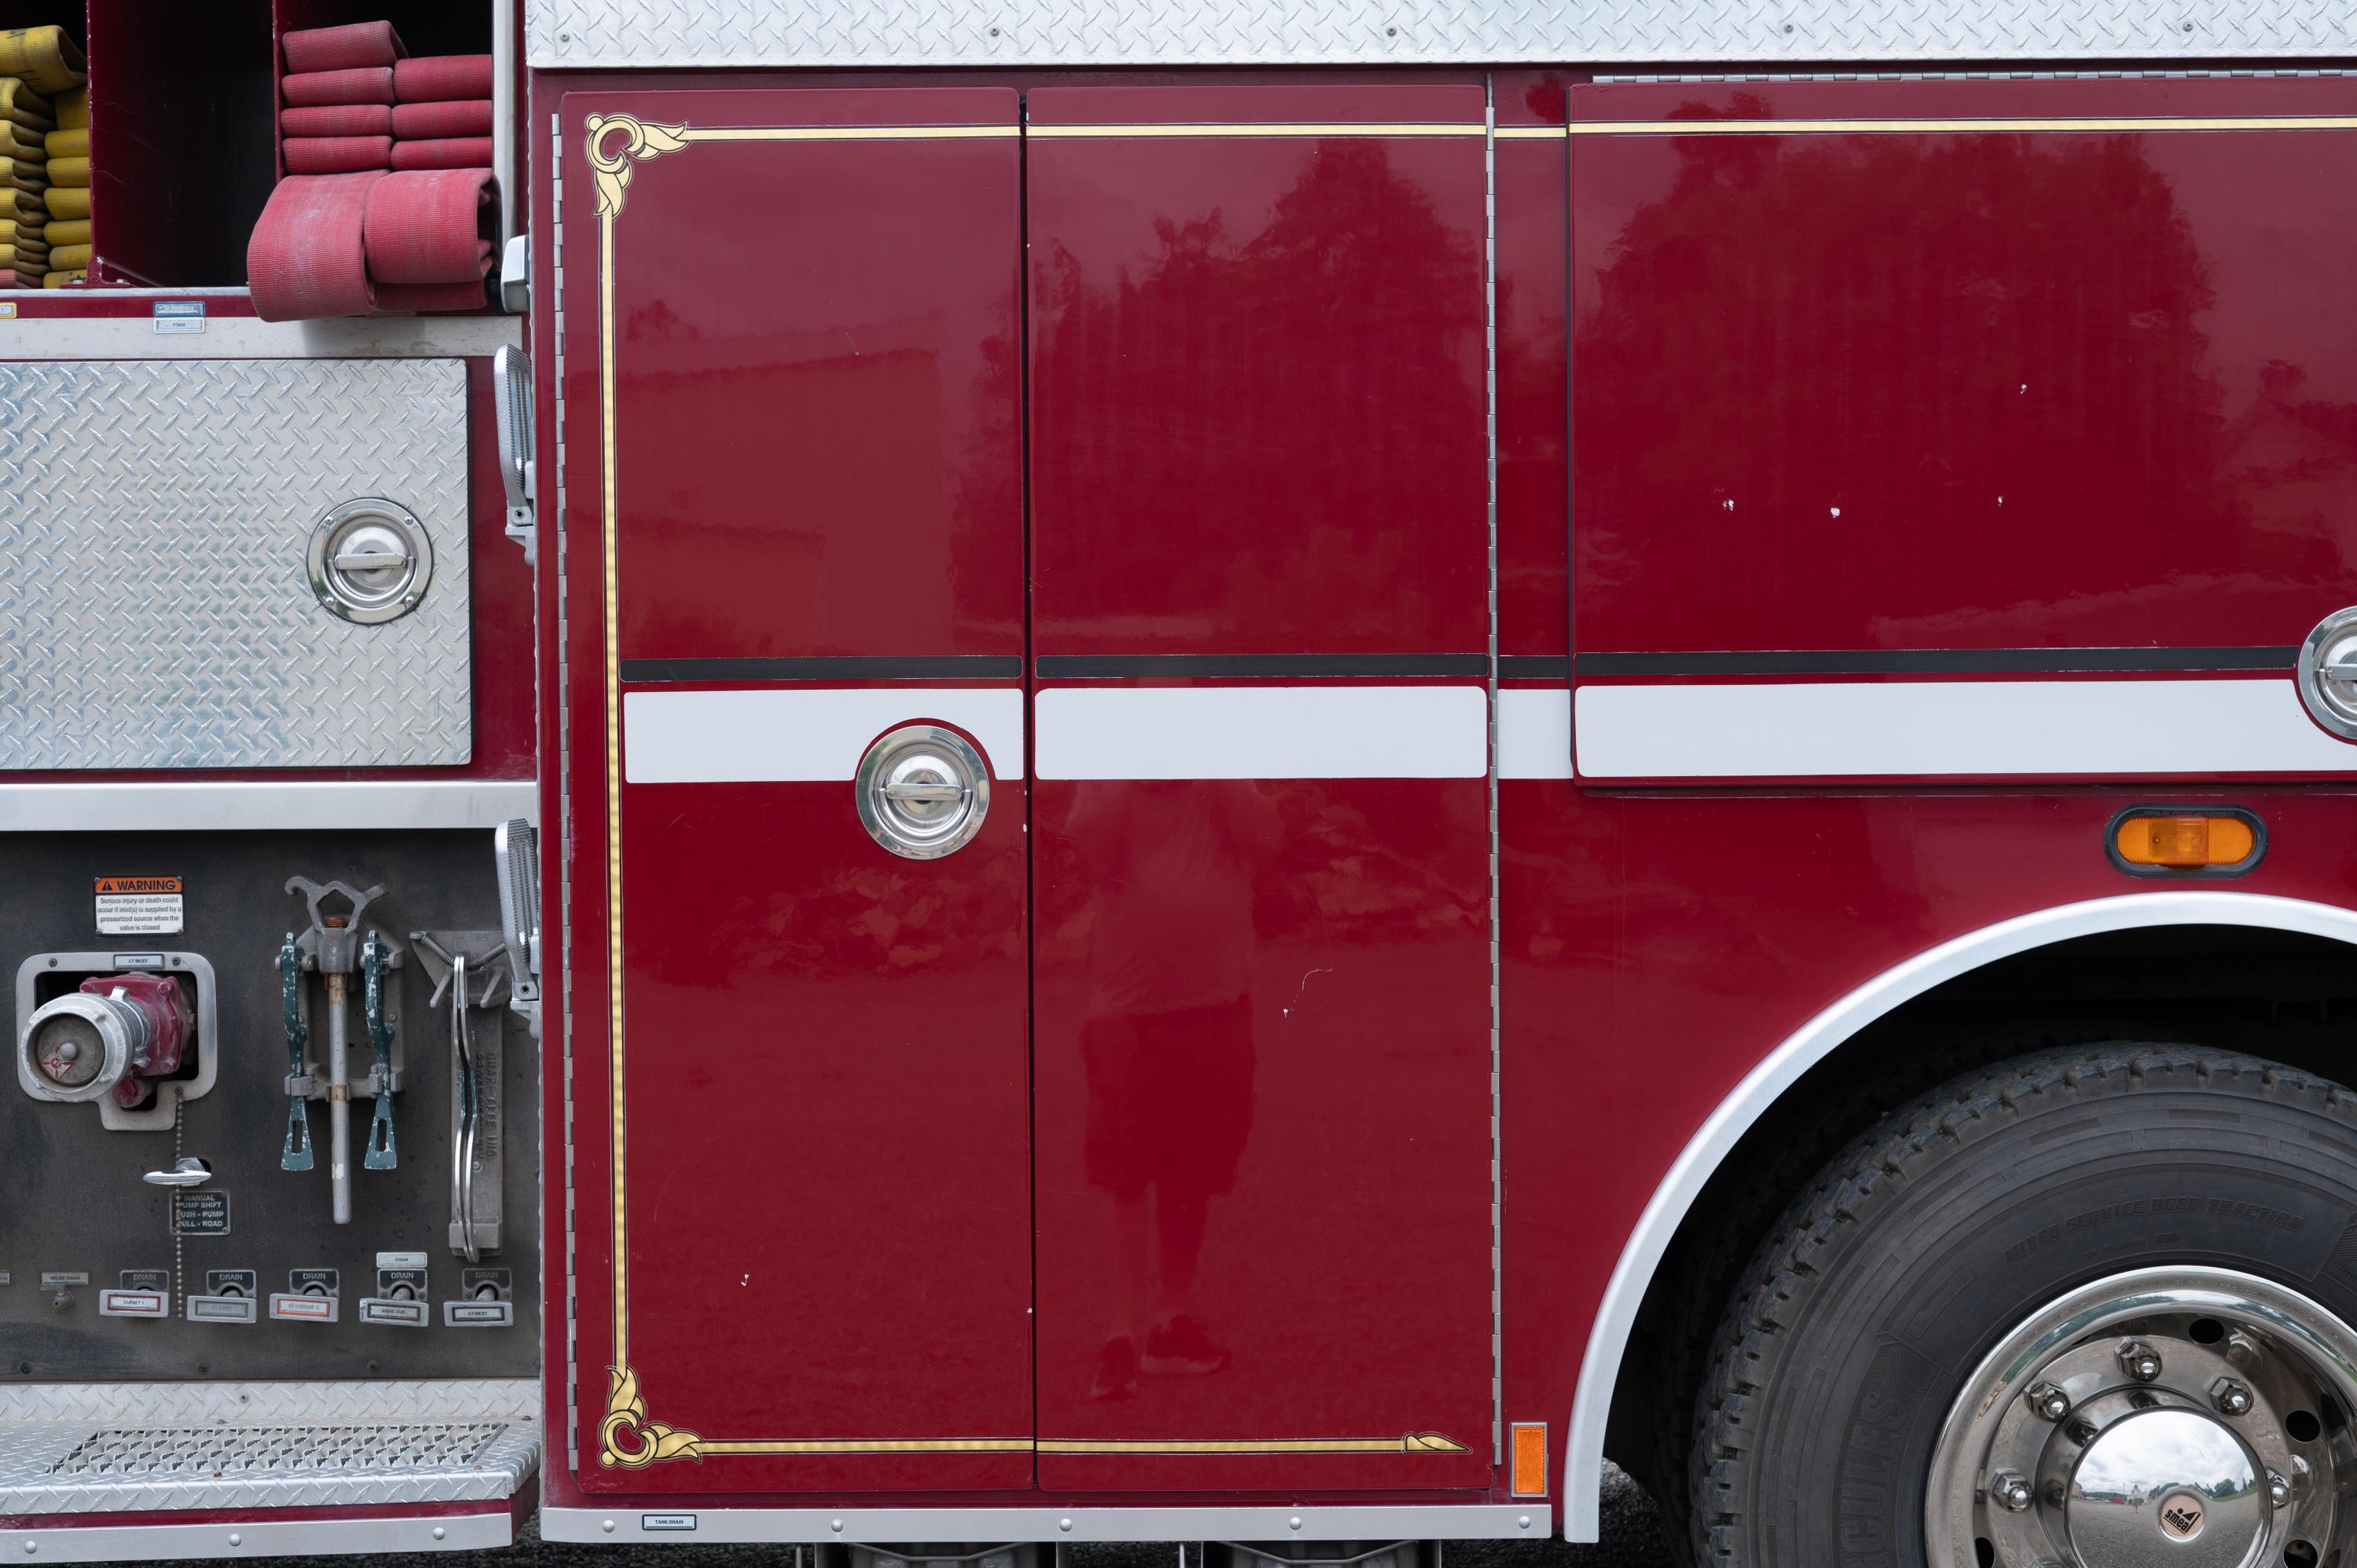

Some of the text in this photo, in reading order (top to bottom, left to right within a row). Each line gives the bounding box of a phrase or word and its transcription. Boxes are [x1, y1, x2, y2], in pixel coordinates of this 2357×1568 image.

[116, 880, 176, 891] WARNING
[2003, 1223, 2062, 1267] MIXED
[2066, 1199, 2144, 1236] SERVICE
[2150, 1196, 2201, 1214] DEEP
[2206, 1196, 2307, 1233] TRACTION
